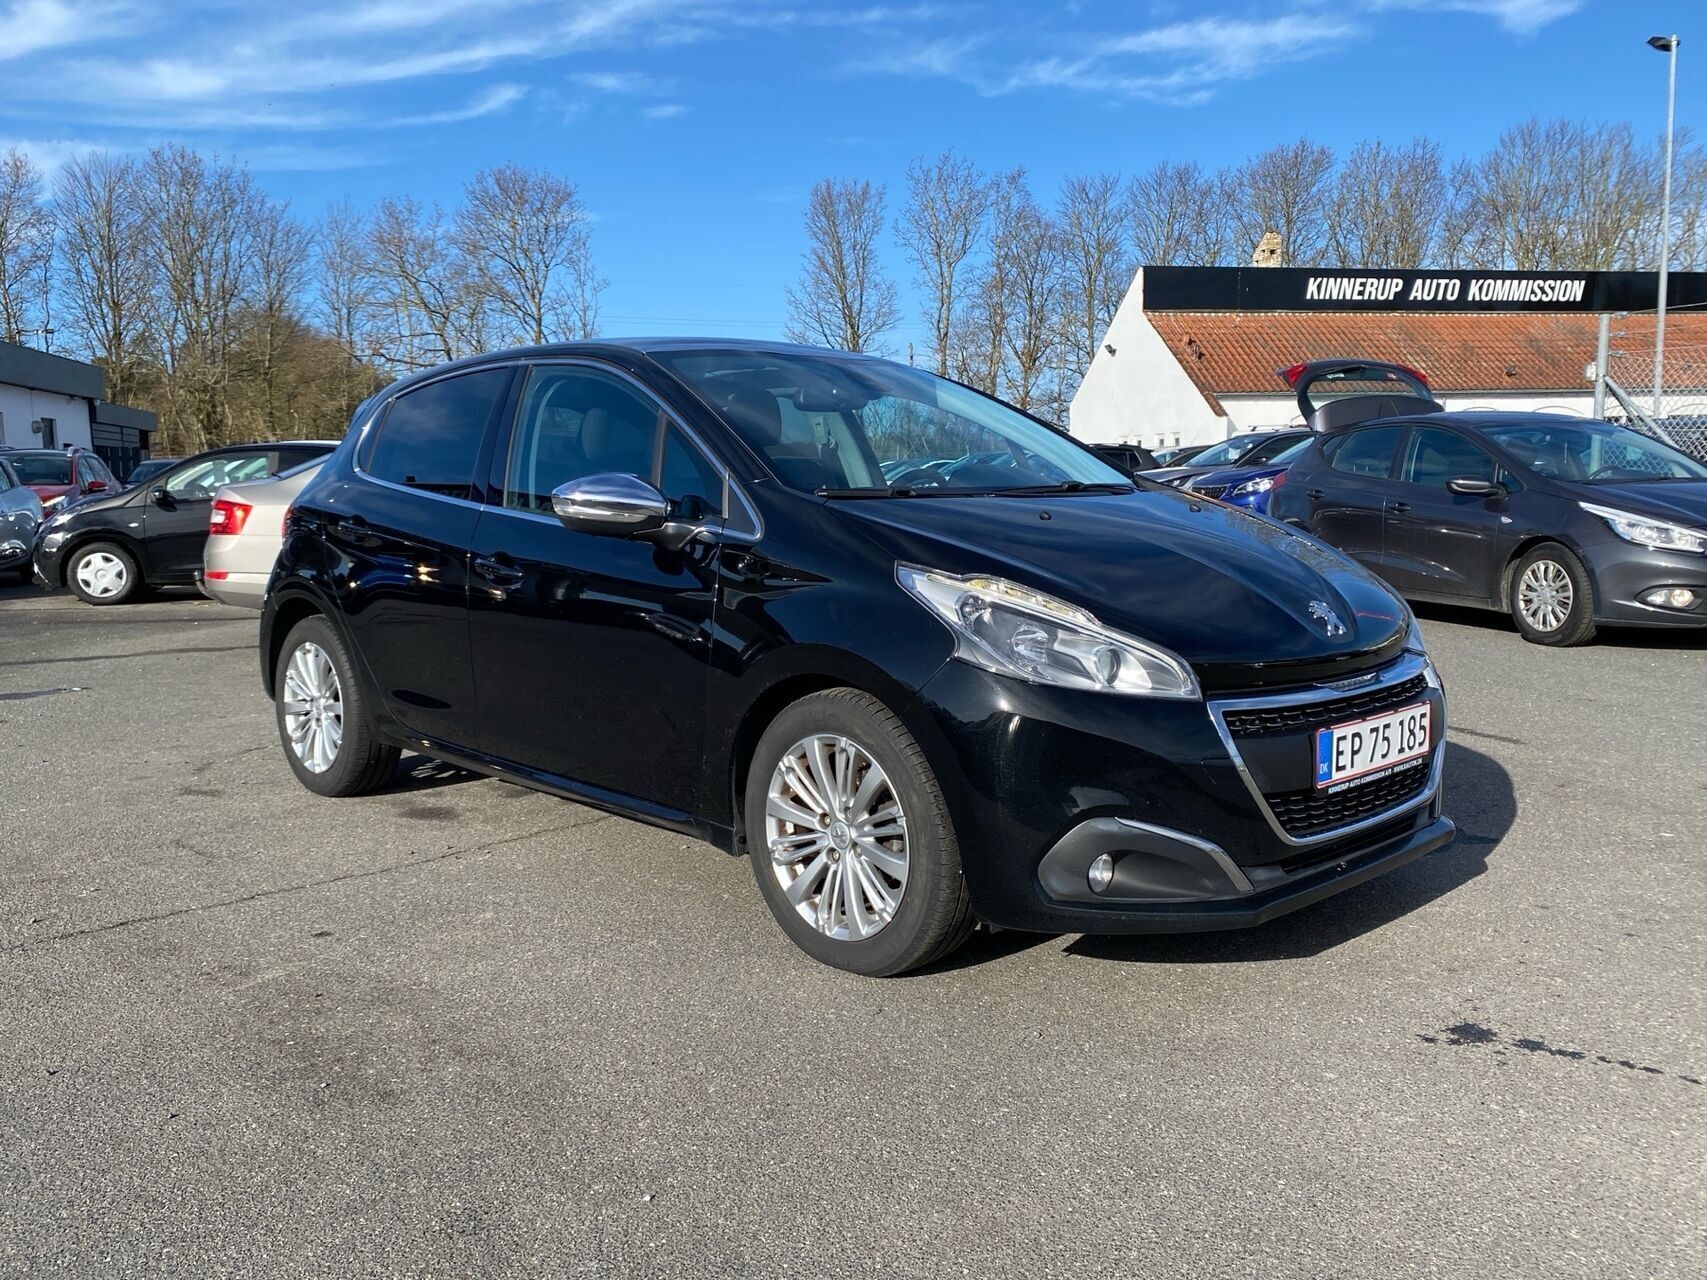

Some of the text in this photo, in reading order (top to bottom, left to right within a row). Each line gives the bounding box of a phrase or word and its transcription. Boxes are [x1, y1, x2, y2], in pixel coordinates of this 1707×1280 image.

[1306, 277, 1586, 302] KINNERUP AUTO KOMMISSION
[1335, 712, 1427, 773] EP 75 185
